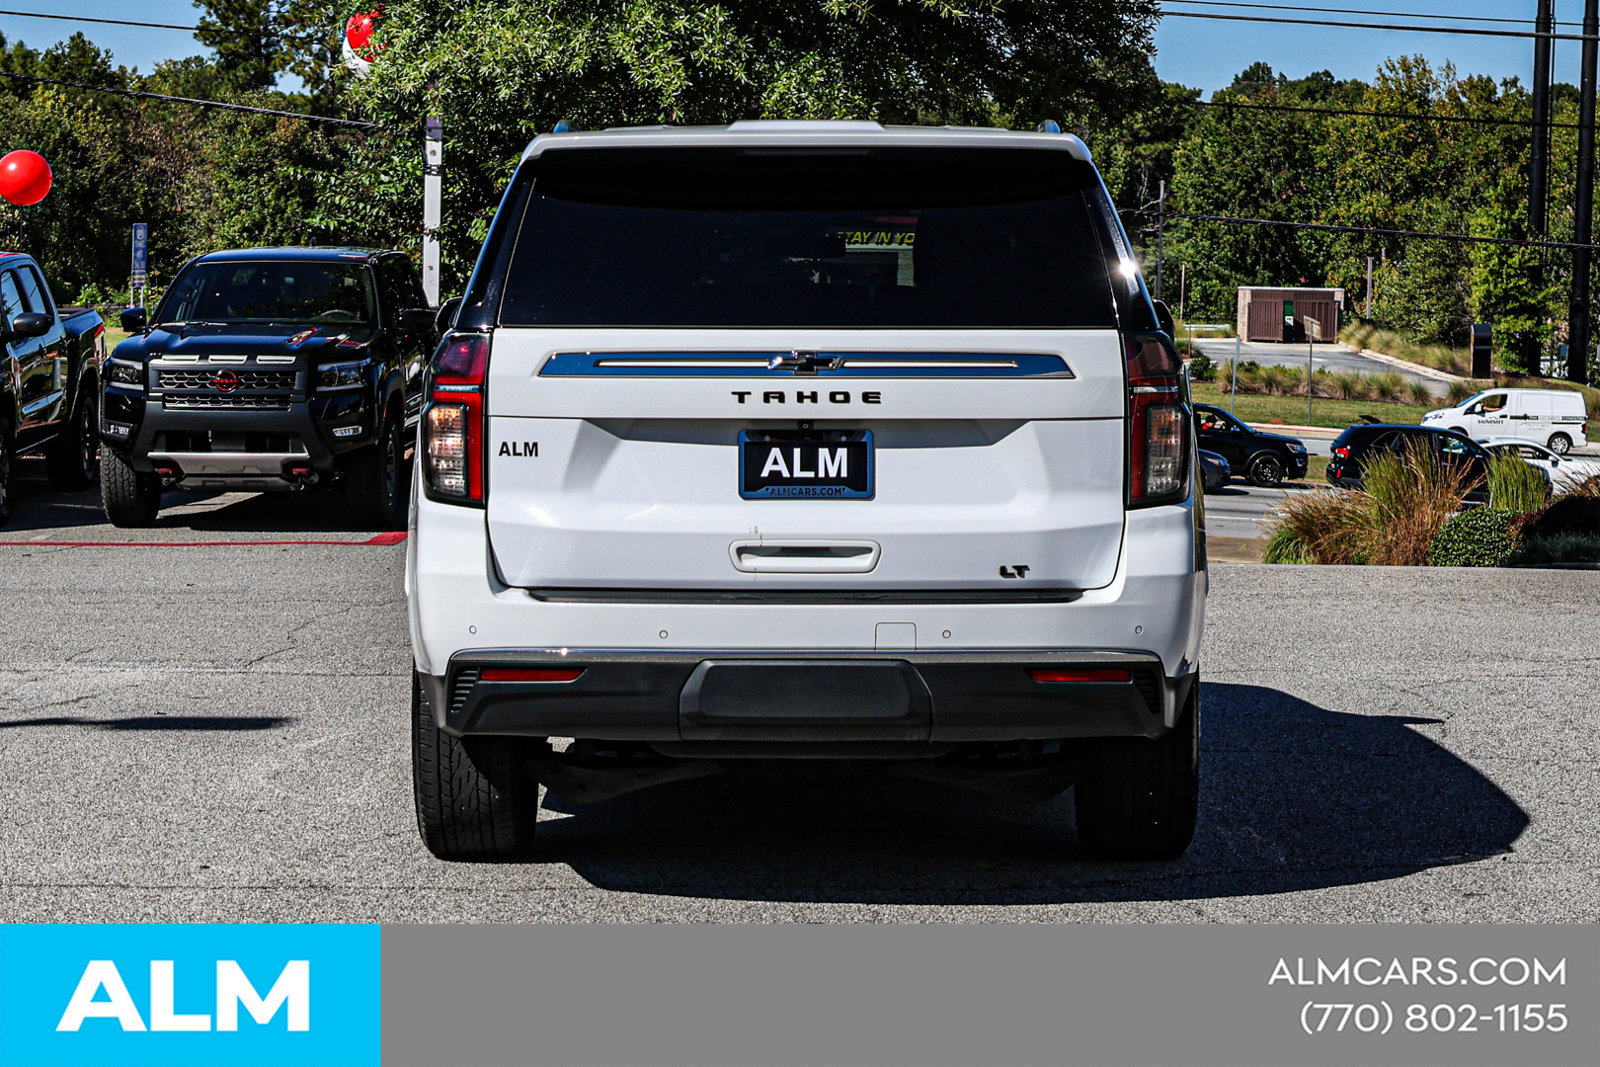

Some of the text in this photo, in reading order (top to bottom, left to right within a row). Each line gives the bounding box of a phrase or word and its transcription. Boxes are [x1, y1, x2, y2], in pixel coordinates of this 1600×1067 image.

[874, 231, 892, 243] IN
[731, 391, 882, 405] TAHOE
[498, 441, 539, 458] ALM
[760, 447, 848, 478] ALM
[770, 487, 842, 496] ALMCARS.COM
[999, 564, 1031, 579] LT
